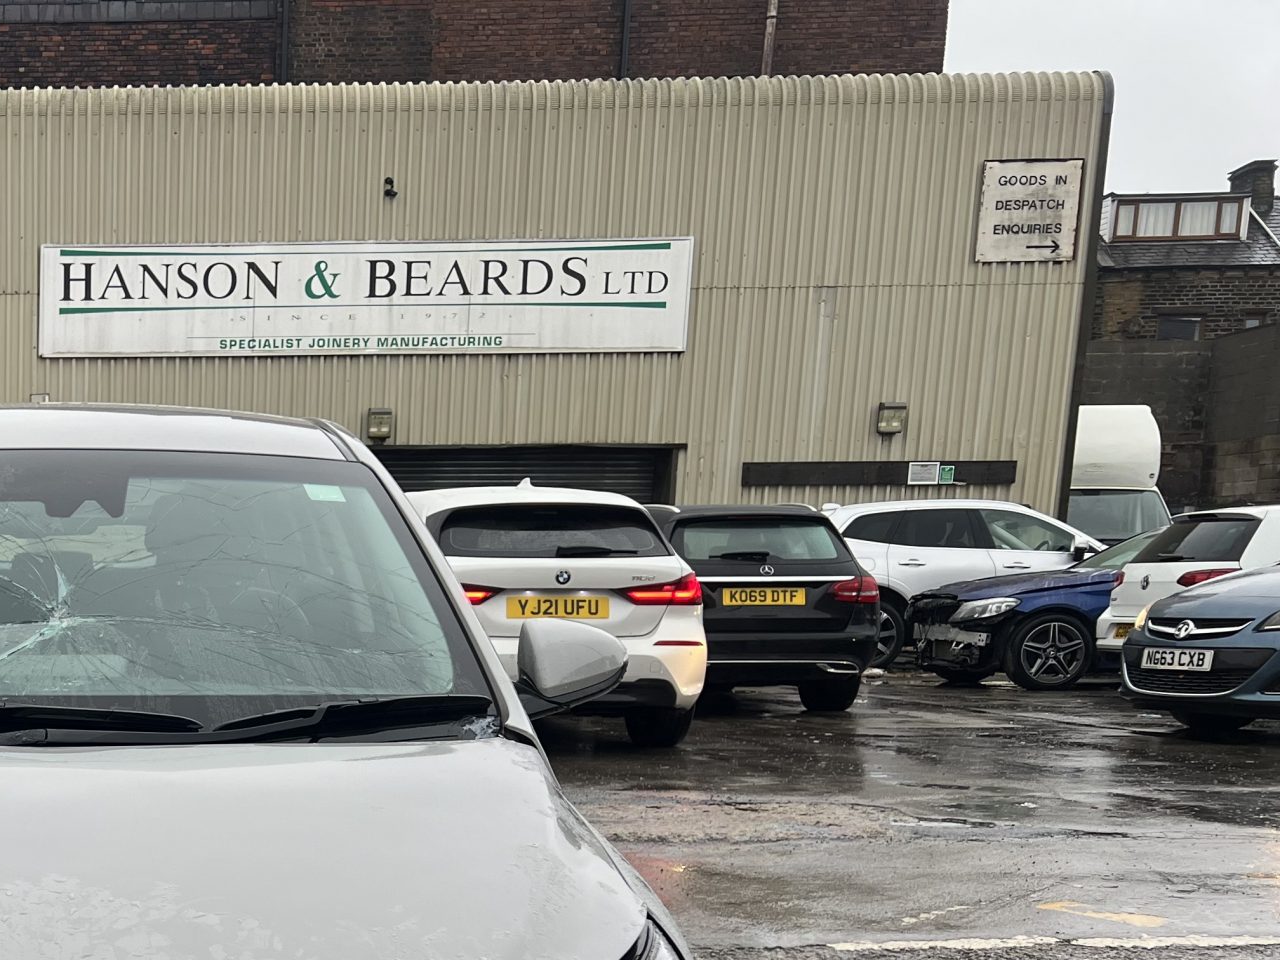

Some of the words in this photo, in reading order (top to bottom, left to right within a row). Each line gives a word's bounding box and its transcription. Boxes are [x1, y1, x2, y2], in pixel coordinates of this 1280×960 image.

[998, 175, 1047, 186] GOODS
[1055, 175, 1067, 185] IN
[995, 199, 1065, 211] DESPATCH
[992, 223, 1062, 235] ENQUIRIES
[59, 260, 282, 302] HANSON
[304, 260, 341, 299] &
[364, 257, 588, 298] BEARDS
[602, 270, 669, 294] LTD
[239, 312, 358, 321] SINCE
[219, 338, 302, 350] SPECIALIST
[308, 337, 370, 349] JOINERY
[376, 335, 503, 348] MANUFACTURING
[771, 589, 798, 603] DTF
[518, 599, 558, 615] YJ21
[563, 599, 599, 615] UFU
[1146, 650, 1175, 666] NG63
[1178, 652, 1206, 667] CXB
